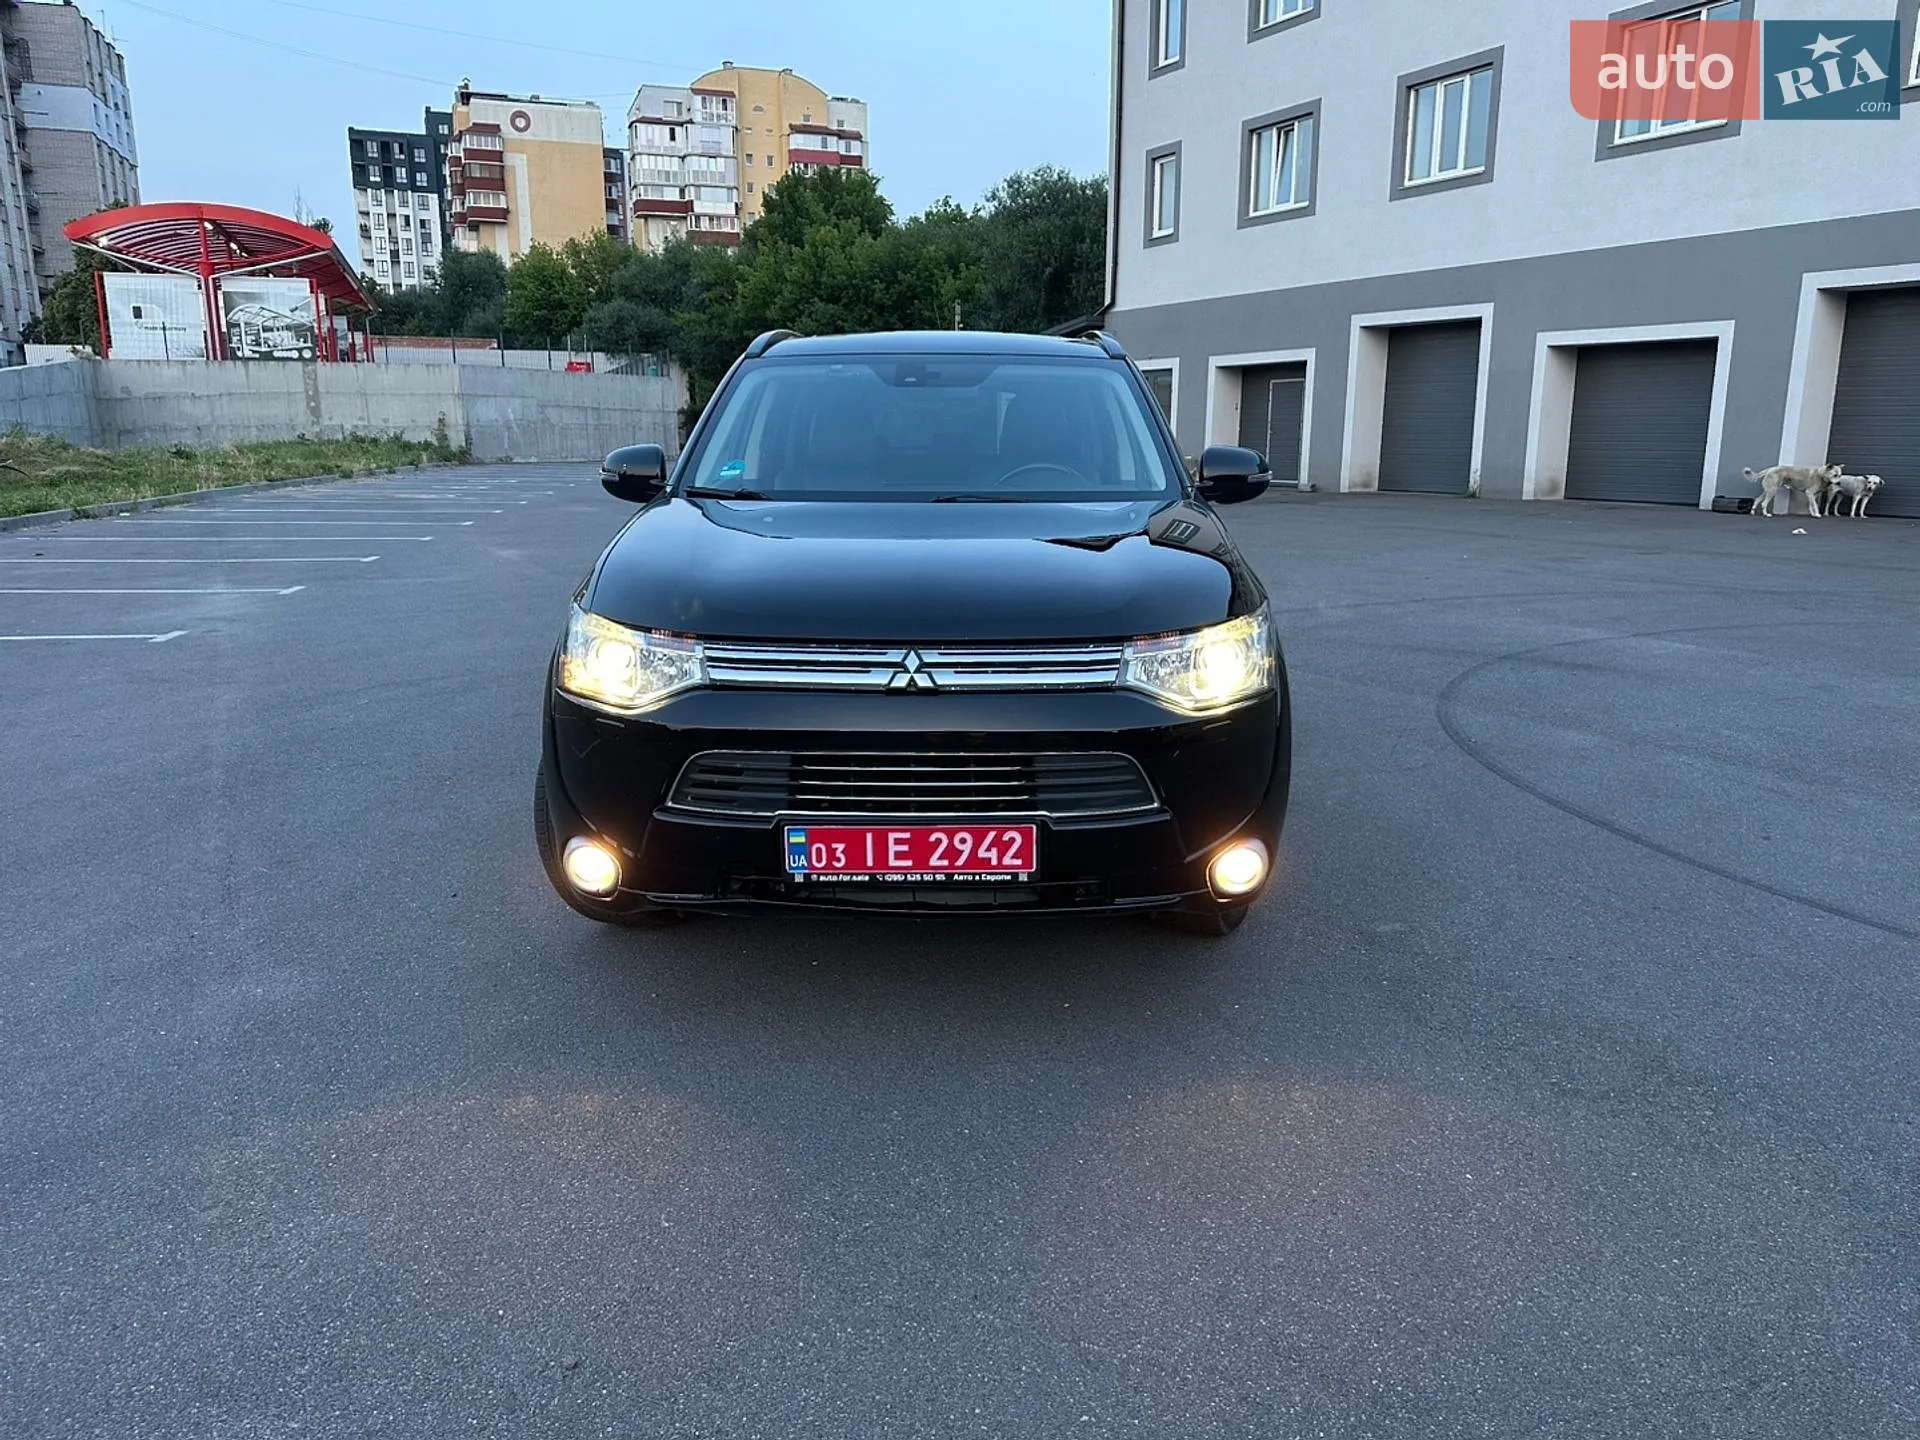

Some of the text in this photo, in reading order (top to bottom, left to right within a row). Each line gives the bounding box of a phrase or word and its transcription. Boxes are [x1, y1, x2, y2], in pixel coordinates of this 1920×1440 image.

[789, 854, 808, 868] UA
[811, 830, 1023, 869] 03 IE 2942
